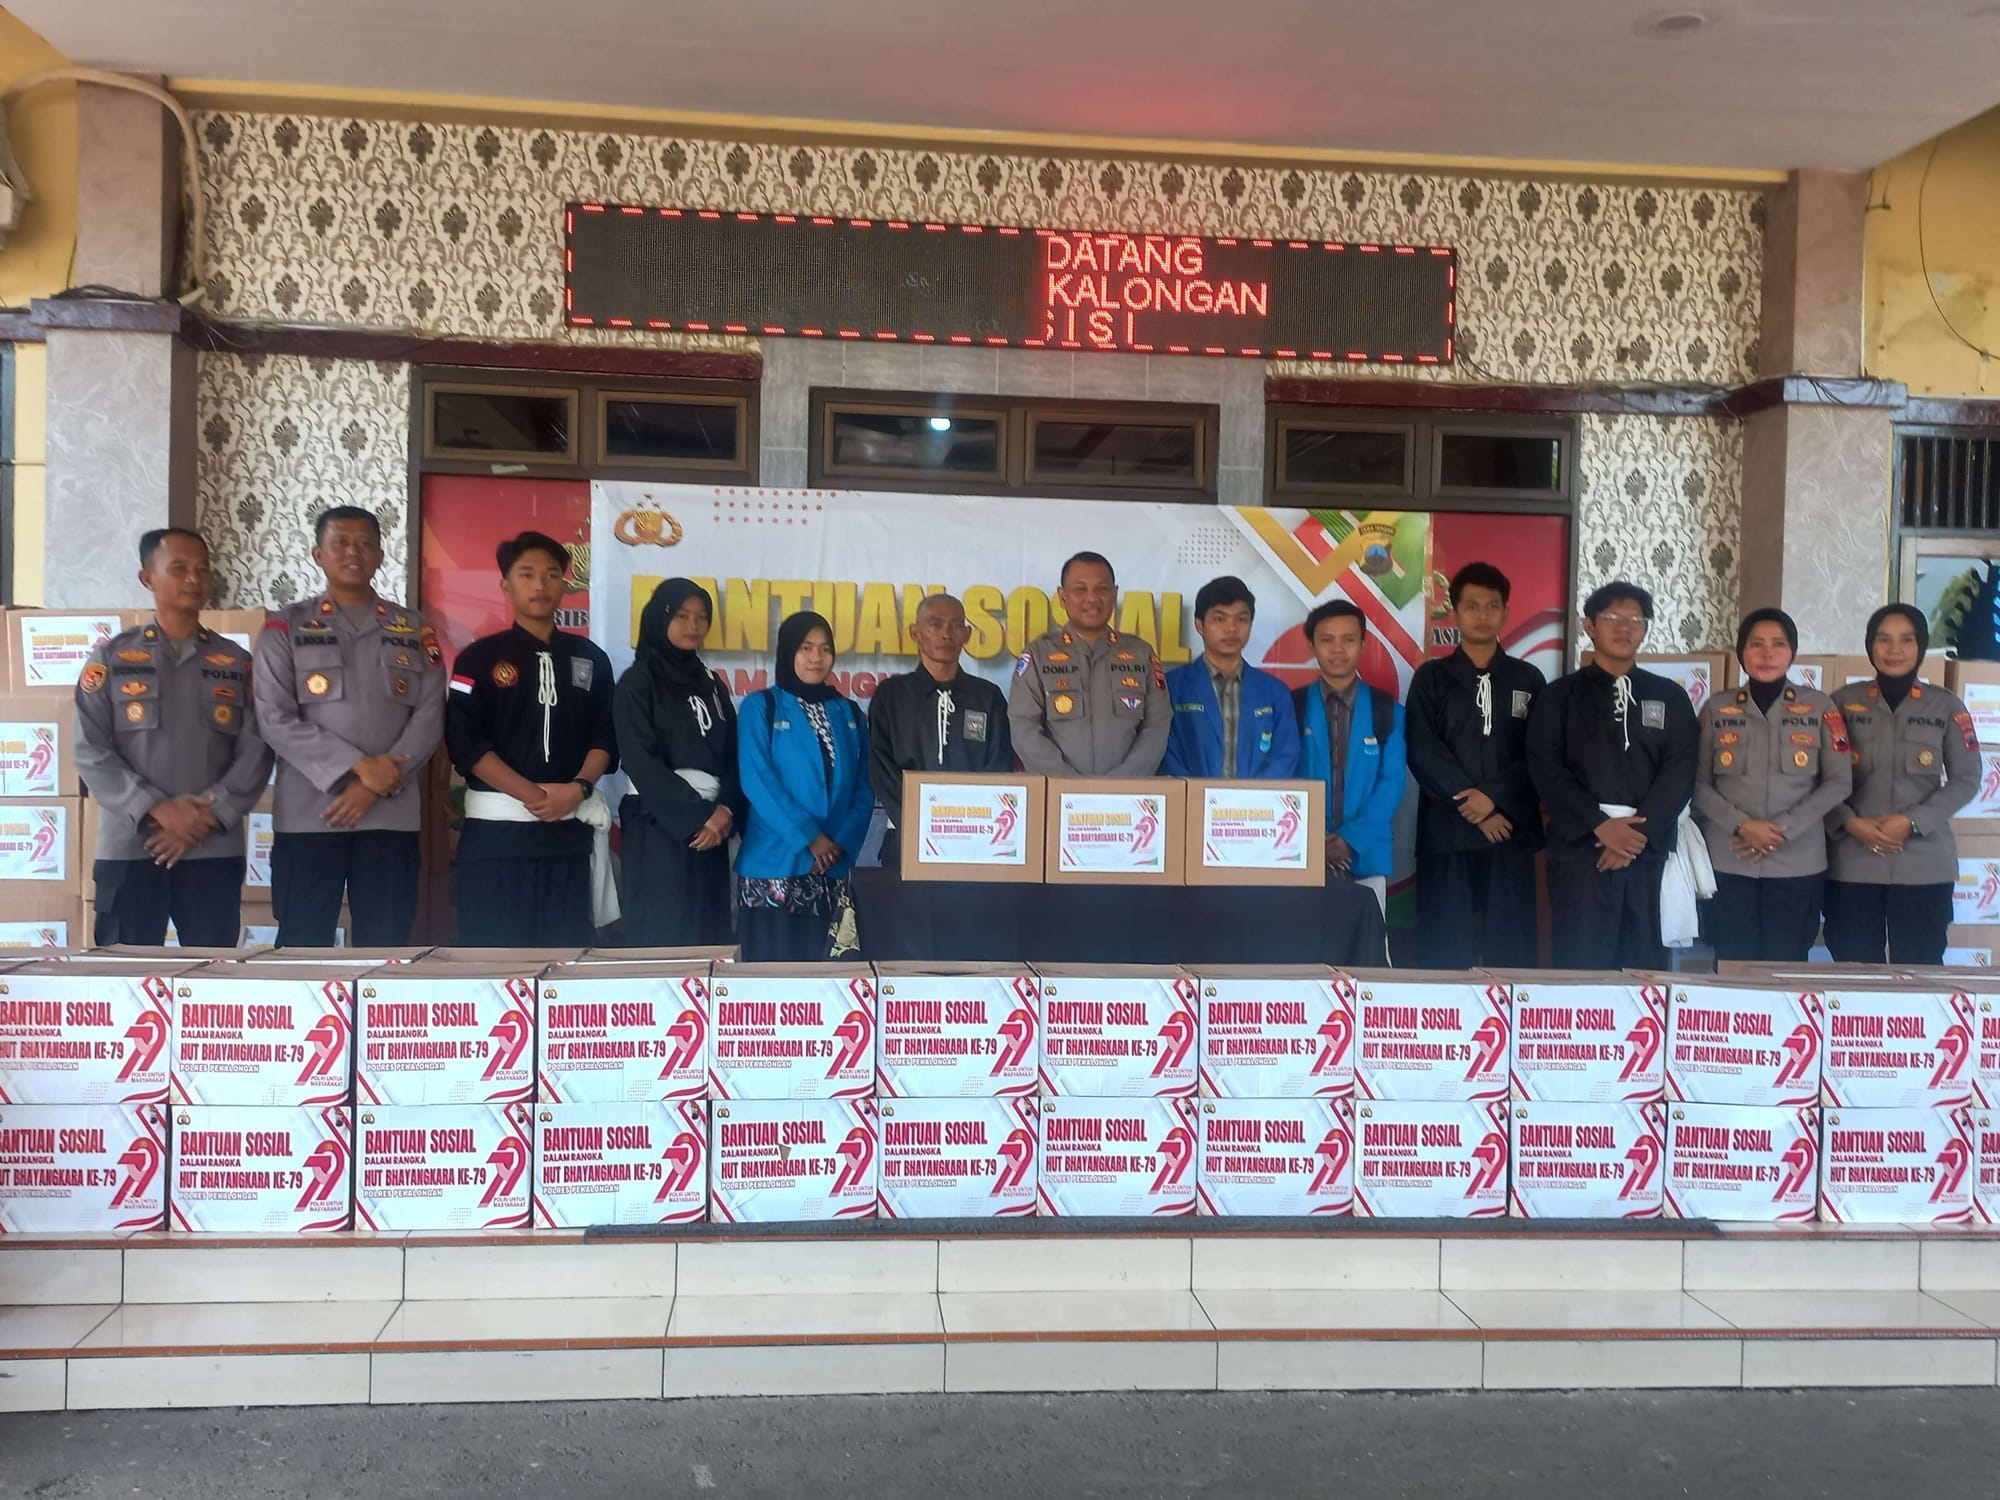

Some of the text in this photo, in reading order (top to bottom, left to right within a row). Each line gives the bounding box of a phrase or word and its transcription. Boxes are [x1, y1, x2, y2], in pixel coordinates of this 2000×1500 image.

[1047, 236, 1203, 275] DATANG
[1048, 273, 1267, 316] KALONGAN
[962, 584, 1192, 664] SOAL
[381, 635, 419, 650] POLRI
[201, 669, 243, 682] POLRI
[1111, 663, 1146, 673] POLRI
[1782, 717, 1818, 727] POLRI
[1908, 716, 1945, 728] POLRI
[0, 1000, 114, 1027] BANTUAN SOSIAL
[181, 1003, 294, 1029] BANTUAN SOSIAL
[367, 1003, 479, 1028] BANTUAN SOSIAL
[548, 1002, 656, 1029] BANTUAN SOSIAL
[719, 1002, 824, 1026] BANTUAN SOSIAL
[885, 1000, 988, 1024] BANTUAN SOSIAL
[1047, 1001, 1149, 1026] BANTUAN SOSIAL
[1208, 1001, 1307, 1025] BANTUAN SOSIAL
[1364, 1006, 1462, 1030] BANTUAN SOSIAL
[1519, 1007, 1616, 1031] BANTUAN SOSIAL
[1208, 1027, 1263, 1036] DALAM RANGKA
[1677, 1008, 1773, 1036] BANTUAN SOSIAL
[1832, 1015, 1926, 1038] BANTUAN SOSIAL
[180, 1031, 243, 1041] DALAM RANGKA
[367, 1029, 428, 1040] DALAM RANGKA
[718, 1028, 776, 1038] DALAM RANGKA
[20, 1042, 92, 1059] BHAYANGKARA
[95, 1042, 124, 1059] KE-79
[181, 1043, 304, 1061] HUT BHAYANGKARA KE-79
[367, 1041, 488, 1060] HUT BHAYANGKARA KE-79
[548, 1041, 666, 1060] HUT BHAYANGKARA KE-79
[718, 1041, 833, 1057] HUT BHAYANGKARA KE-79
[885, 1039, 997, 1055] HUT BHAYANGKARA KE-79
[1046, 1039, 1158, 1056] HUT BHAYANGKARA KE-79
[1208, 1039, 1317, 1055] HUT BHAYANGKARA KE-79
[1363, 1043, 1471, 1060] HUT BHAYANGKARA KE-79
[1519, 1044, 1624, 1060] HUT BHAYANGKARA KE-79
[1675, 1045, 1781, 1064] HUT BHAYANGKARA KE-79
[1831, 1040, 1884, 1050] DALAM RANGKA
[179, 1062, 208, 1071] POLRES
[366, 1062, 394, 1071] POLRES
[717, 1059, 743, 1068] POLRES
[1831, 1052, 1935, 1067] HUT BHAYANGKARA KE-79
[543, 1126, 651, 1151] BANTUAN SOSIAL
[722, 1121, 826, 1147] BANTUAN SOSIAL
[885, 1122, 987, 1145] BANTUAN SOSIAL
[1046, 1118, 1147, 1141] BANTUAN SOSIAL
[1207, 1120, 1304, 1142] BANTUAN SOSIAL
[1364, 1124, 1461, 1146] BANTUAN SOSIAL
[1520, 1125, 1615, 1147] BANTUAN SOSIAL
[1675, 1126, 1772, 1150] BANTUAN SOSIAL
[180, 1131, 293, 1156] BANTUAN SOSIAL
[365, 1129, 476, 1154] BANTUAN SOSIAL
[1832, 1131, 1926, 1152] BANTUAN SOSIAL
[543, 1164, 662, 1183] HUT BHAYANGKARA KE-79
[885, 1159, 997, 1176] HUT BHAYANGKARA KE-79
[1206, 1156, 1314, 1173] HUT BHAYANGKARA KE-79
[1519, 1162, 1624, 1178] HUT BHAYANGKARA KE-79
[179, 1171, 303, 1189] HUT BHAYANGKARA KE-79
[365, 1168, 486, 1186] HUT BHAYANGKARA KE-79
[1831, 1167, 1935, 1183] HUT BHAYANGKARA KE-79
